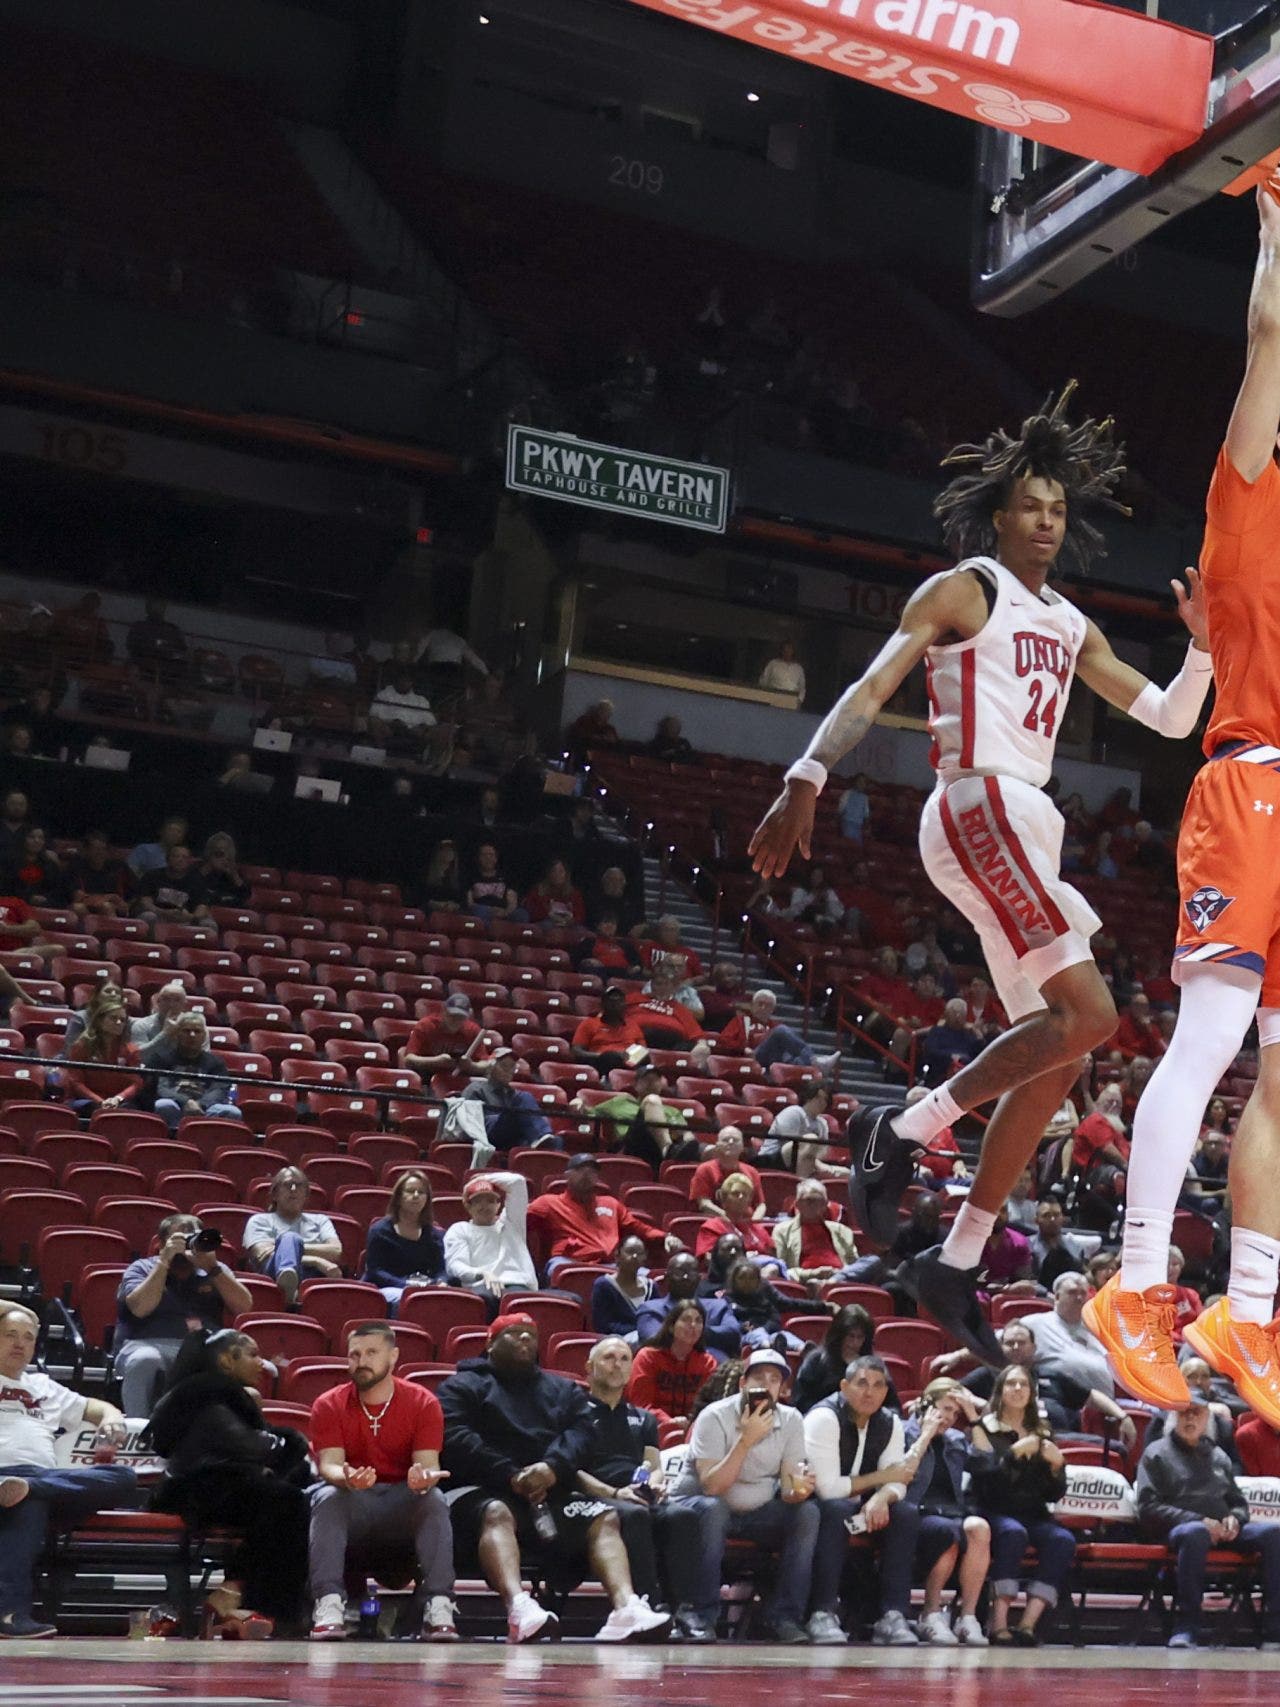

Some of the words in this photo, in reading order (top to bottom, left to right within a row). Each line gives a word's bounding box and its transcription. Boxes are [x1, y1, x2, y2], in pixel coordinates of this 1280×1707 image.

[753, 16, 961, 95] State
[608, 154, 664, 195] 209
[37, 423, 127, 472] 105
[524, 440, 604, 482] PKWY
[614, 460, 714, 505] TAVERN
[522, 468, 607, 498] TAPHOUSE
[616, 490, 648, 506] AND
[656, 497, 712, 519] GRILLE
[1022, 678, 1058, 739] 24
[69, 1453, 158, 1467] TOOTA
